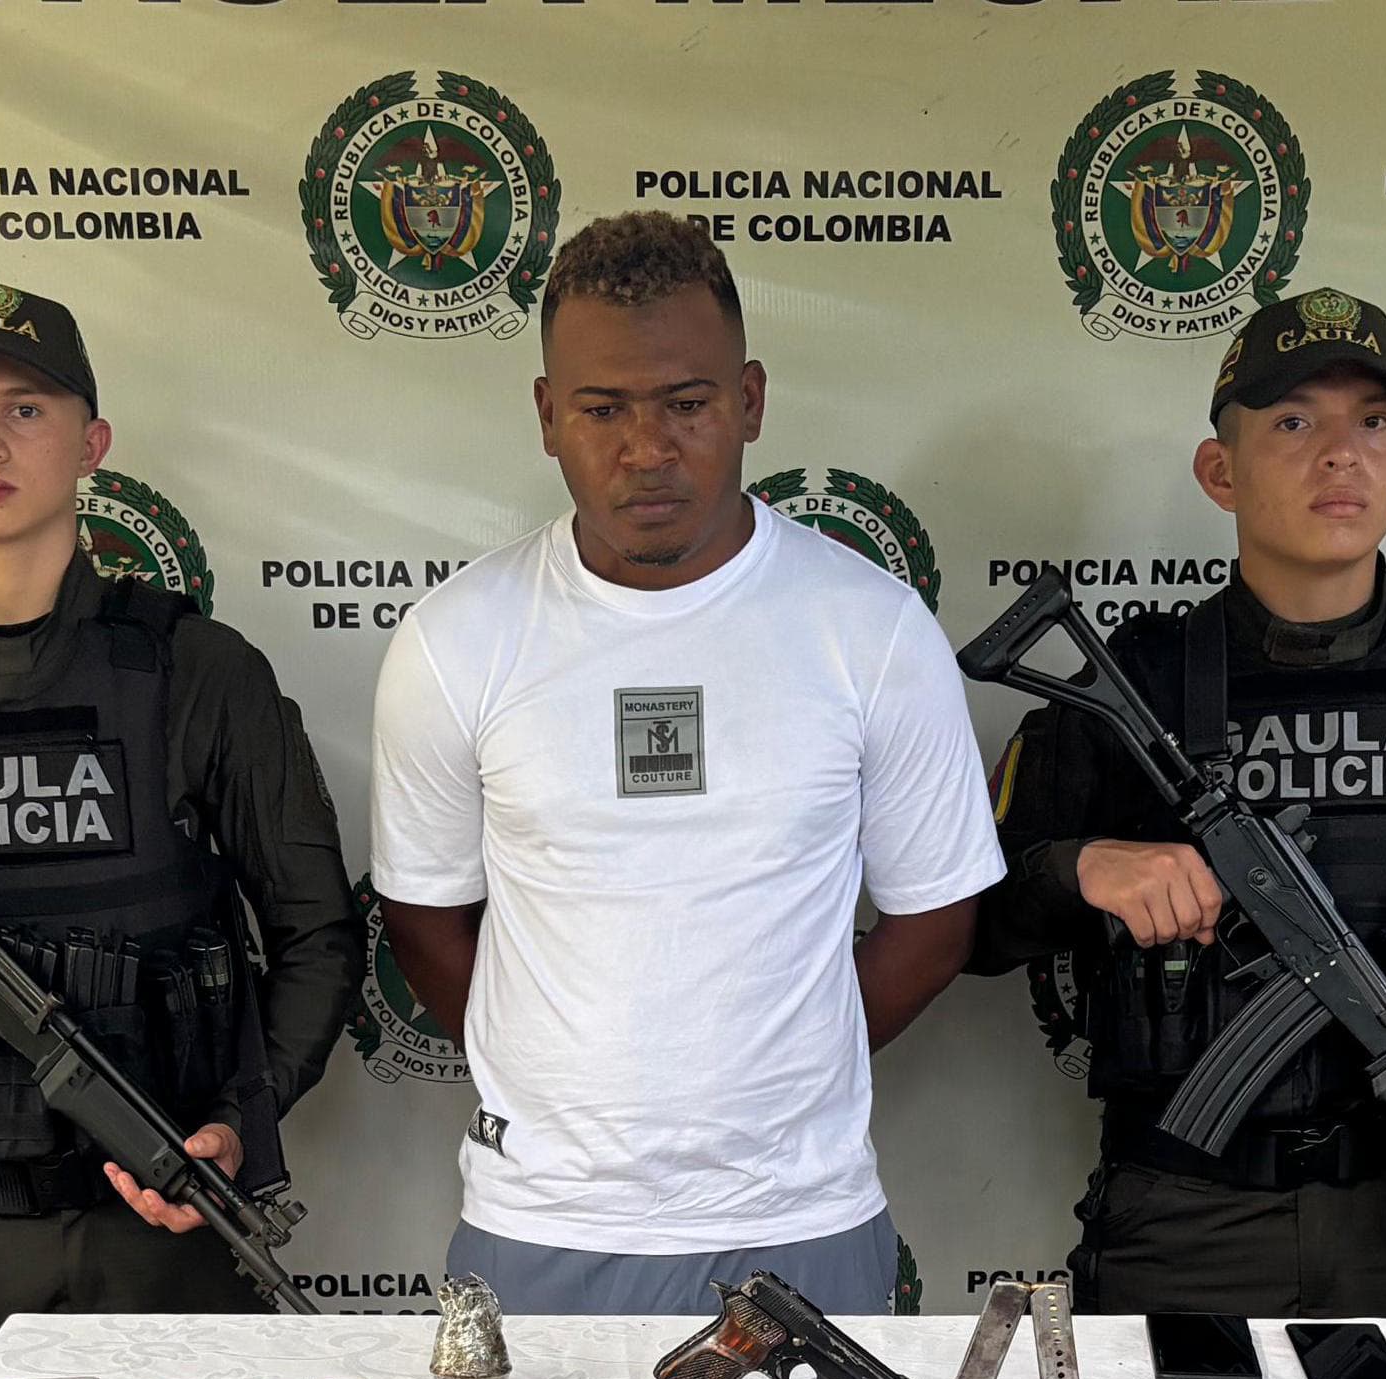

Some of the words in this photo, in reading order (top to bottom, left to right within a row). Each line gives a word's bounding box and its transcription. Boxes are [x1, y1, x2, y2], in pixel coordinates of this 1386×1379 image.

[418, 104, 445, 118] DE
[467, 116, 529, 221] COLOMBIA
[1173, 103, 1201, 117] DE
[1222, 114, 1279, 221] COLOMBIA
[49, 168, 249, 196] NACIONAL
[636, 171, 790, 199] POLICIA
[804, 171, 1002, 199] NACIONAL
[0, 212, 202, 240] COLOMBIA
[749, 215, 951, 242] COLOMBIA
[434, 245, 520, 308] NACIONAL
[1178, 245, 1267, 309] NACIONAL
[435, 304, 499, 332] PATRIA
[1178, 305, 1242, 334] PATRIA
[1276, 328, 1382, 355] GAULA
[262, 561, 413, 587] POLICIA
[313, 603, 360, 628] DE
[625, 701, 694, 712] MONASTERY
[632, 771, 692, 783] COUTURE
[294, 1274, 433, 1297] POLICIA
